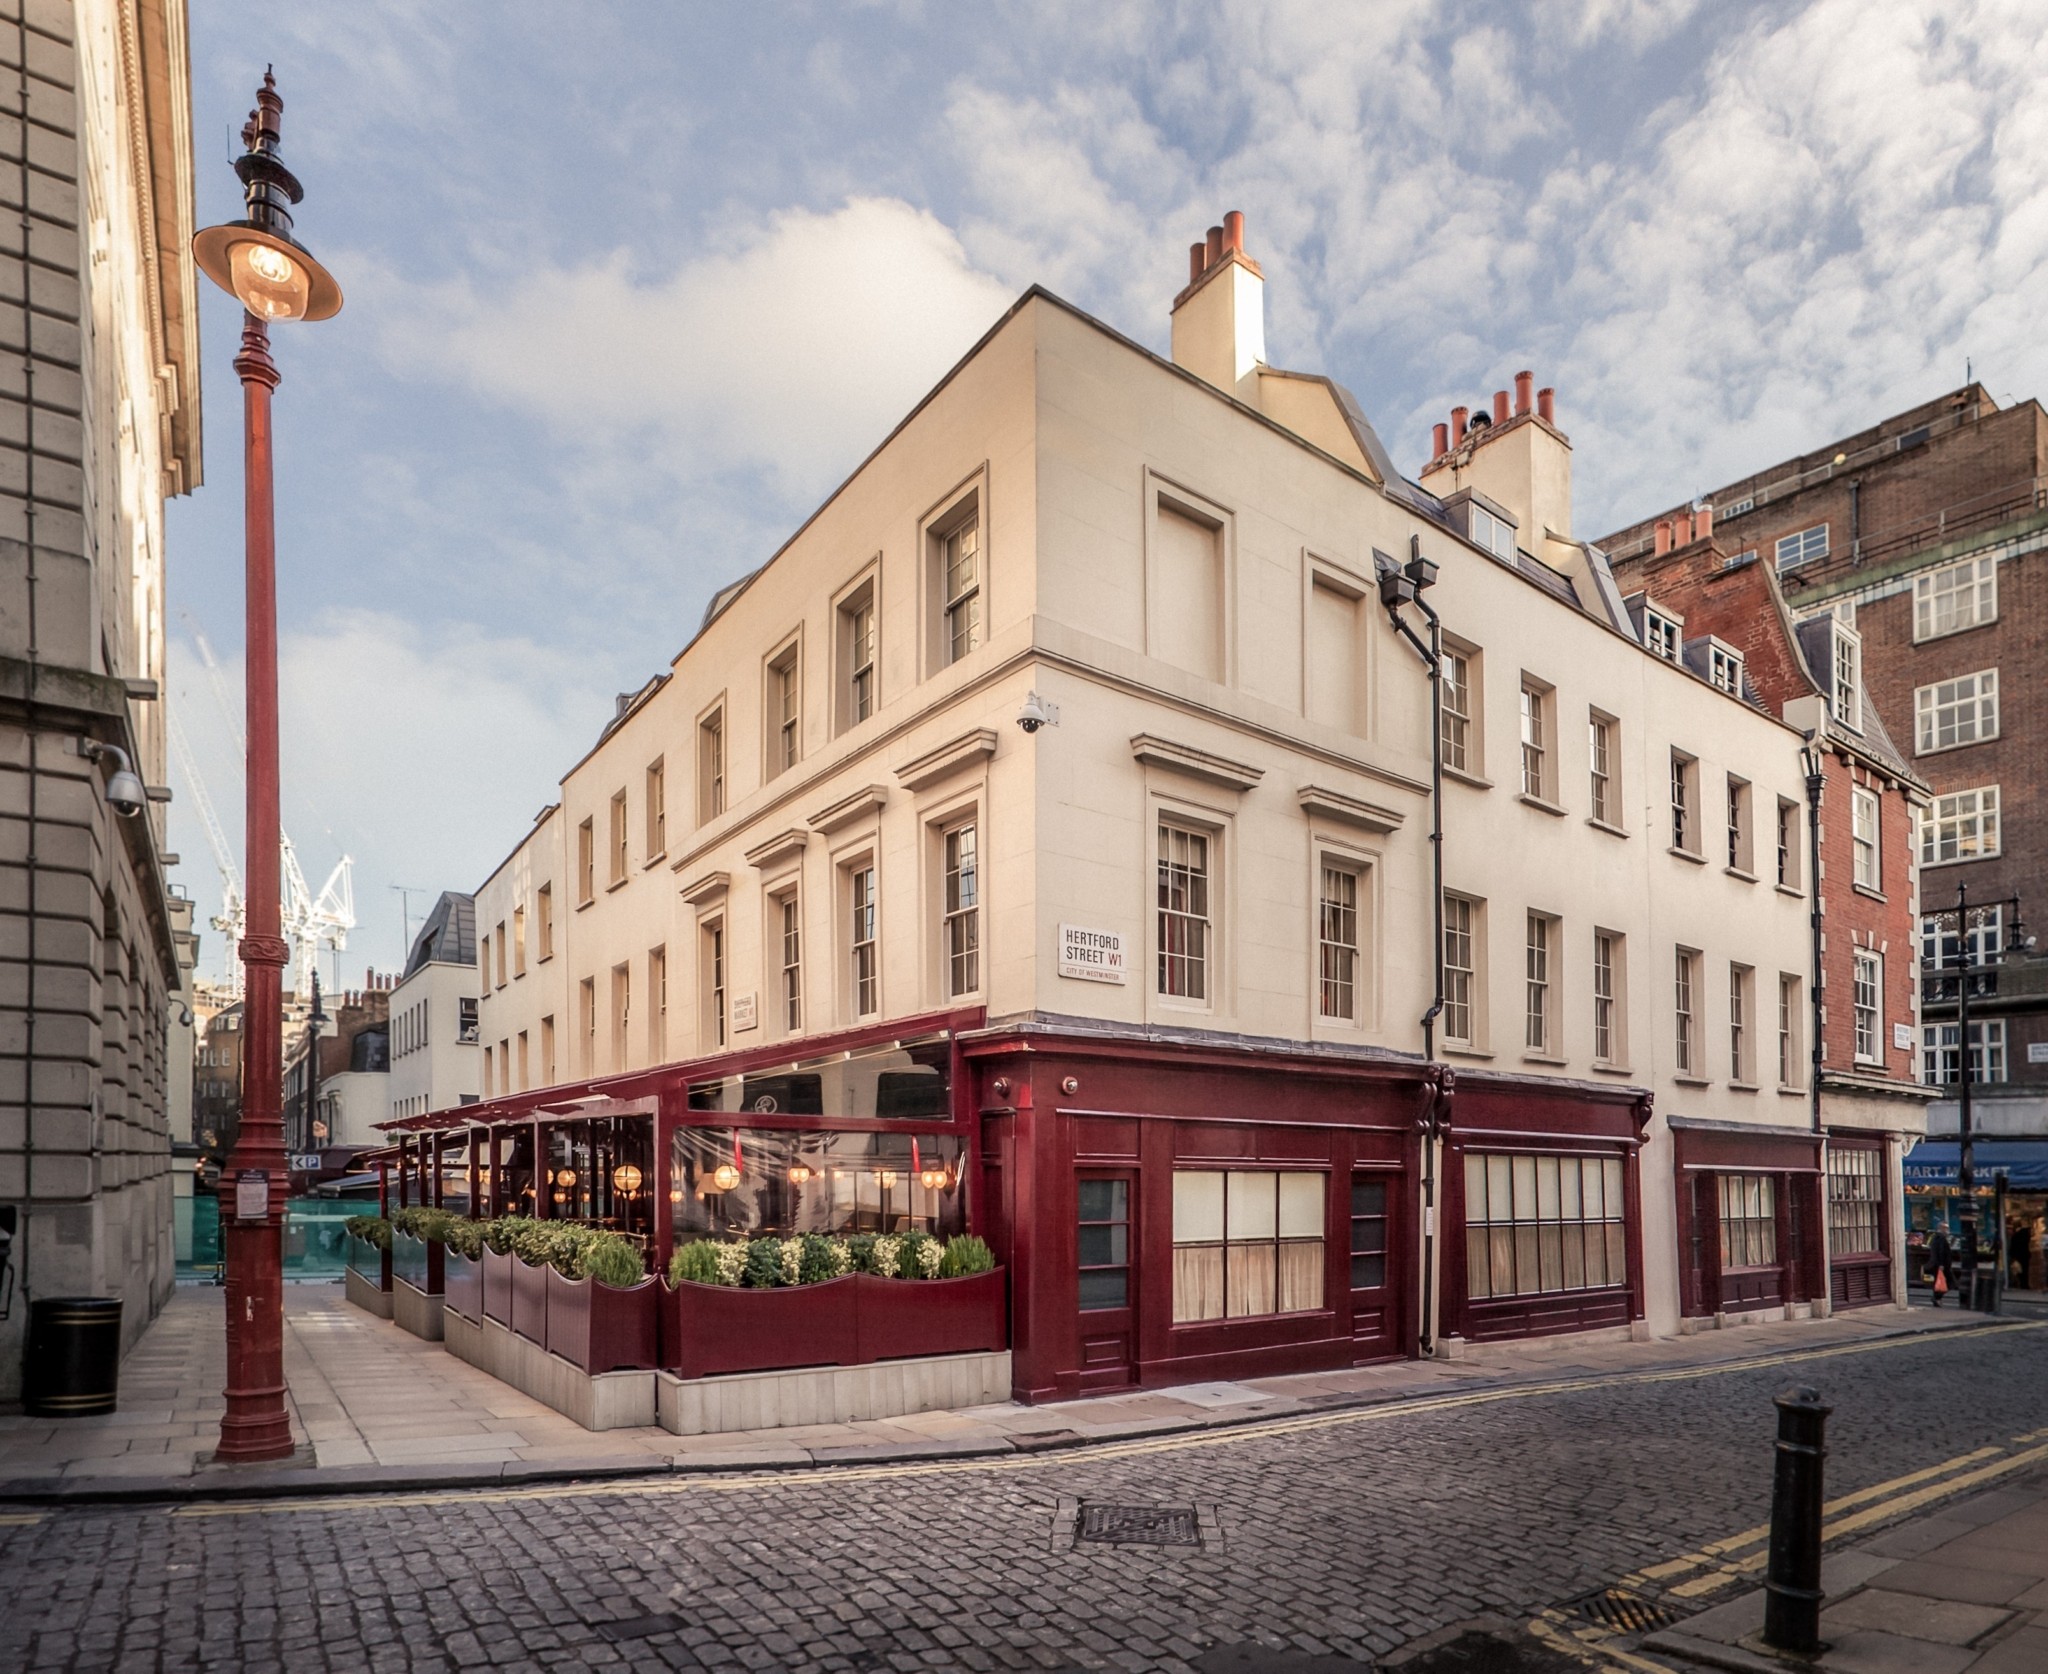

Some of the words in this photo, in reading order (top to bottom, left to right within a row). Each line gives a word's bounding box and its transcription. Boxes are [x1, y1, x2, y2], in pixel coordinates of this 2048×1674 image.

[1066, 929, 1119, 950] HERTFORD
[1066, 946, 1104, 964] STREET
[1108, 953, 1122, 967] W1
[1066, 967, 1077, 975] CITY
[1086, 970, 1119, 980] WESTMINSTER
[307, 1157, 317, 1167] P
